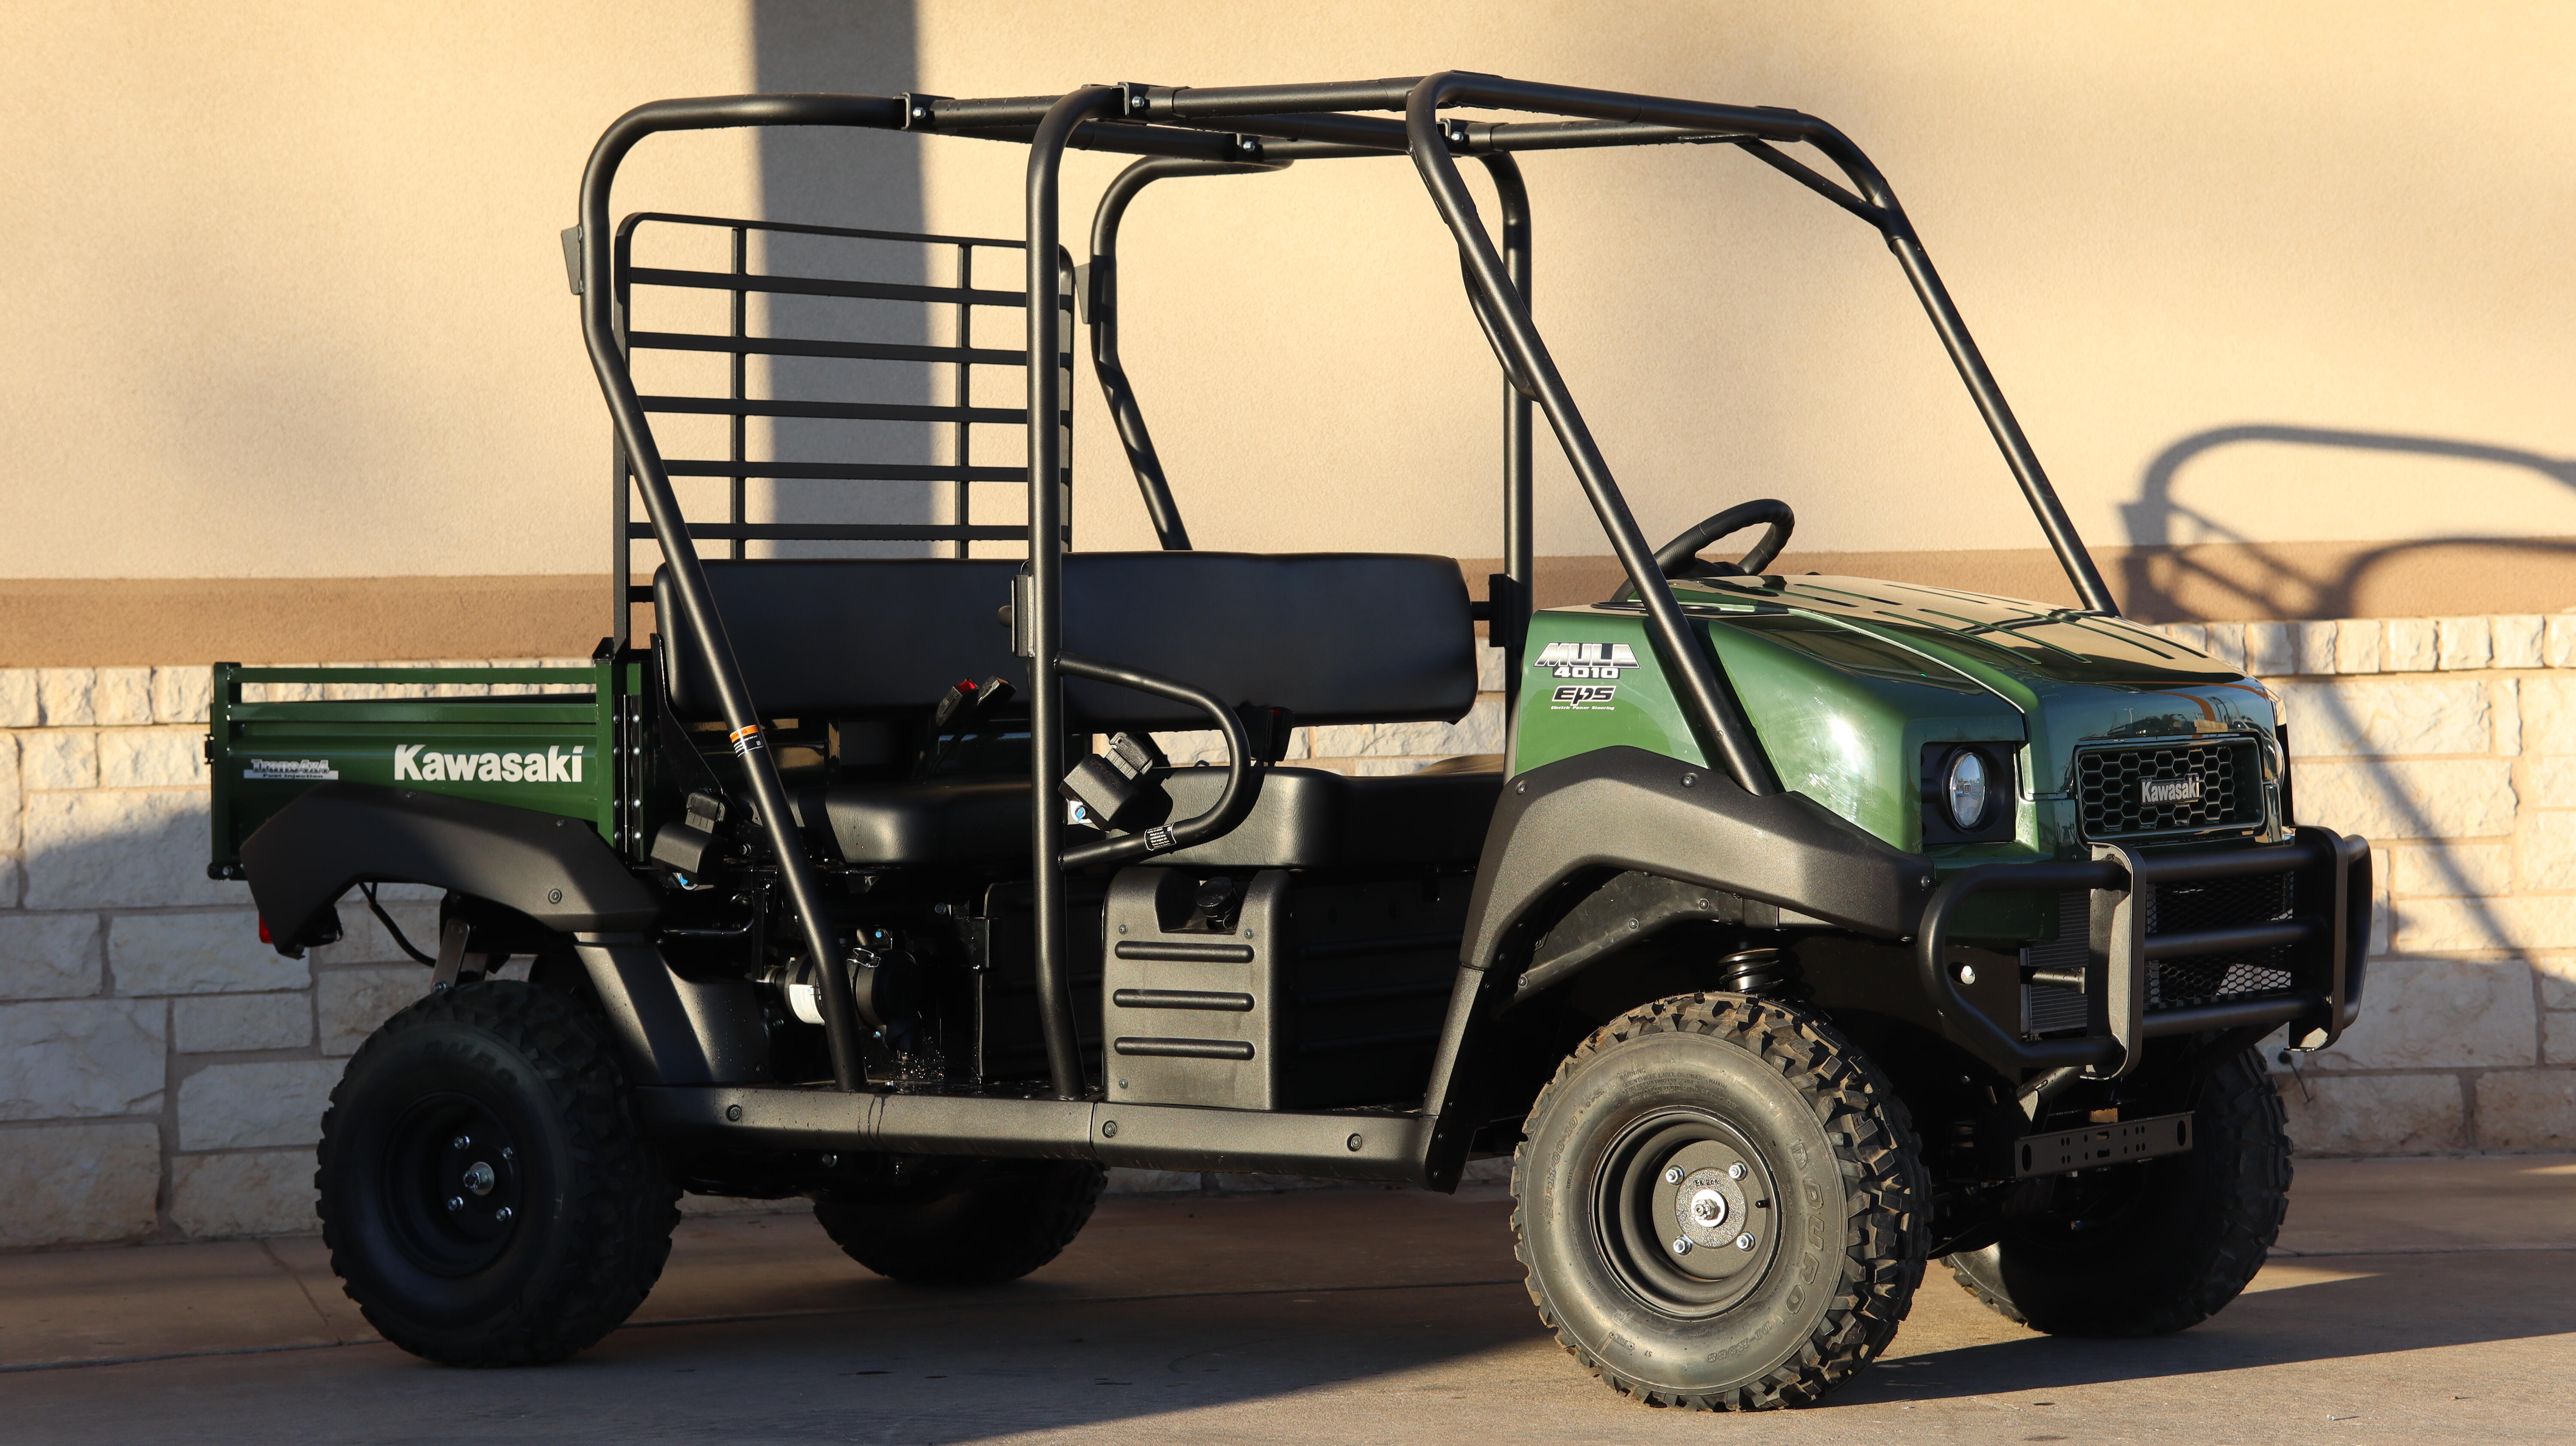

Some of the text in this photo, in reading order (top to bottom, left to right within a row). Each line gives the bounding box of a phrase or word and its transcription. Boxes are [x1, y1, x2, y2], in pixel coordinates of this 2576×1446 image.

[1534, 643, 1640, 668] MULE
[1554, 667, 1619, 678] 4010
[251, 759, 330, 773] Trans4x4
[395, 744, 584, 782] Kawasaki
[2142, 776, 2199, 803] Kawasaki
[1619, 1067, 1646, 1081] WARNING
[1634, 1073, 1657, 1083] VEHICLE
[1709, 1078, 1728, 1090] MANUAL
[1637, 1078, 1666, 1089] OPERATING
[1566, 1165, 1575, 1189] TUBELESS
[1785, 1181, 1824, 1314] DURO
